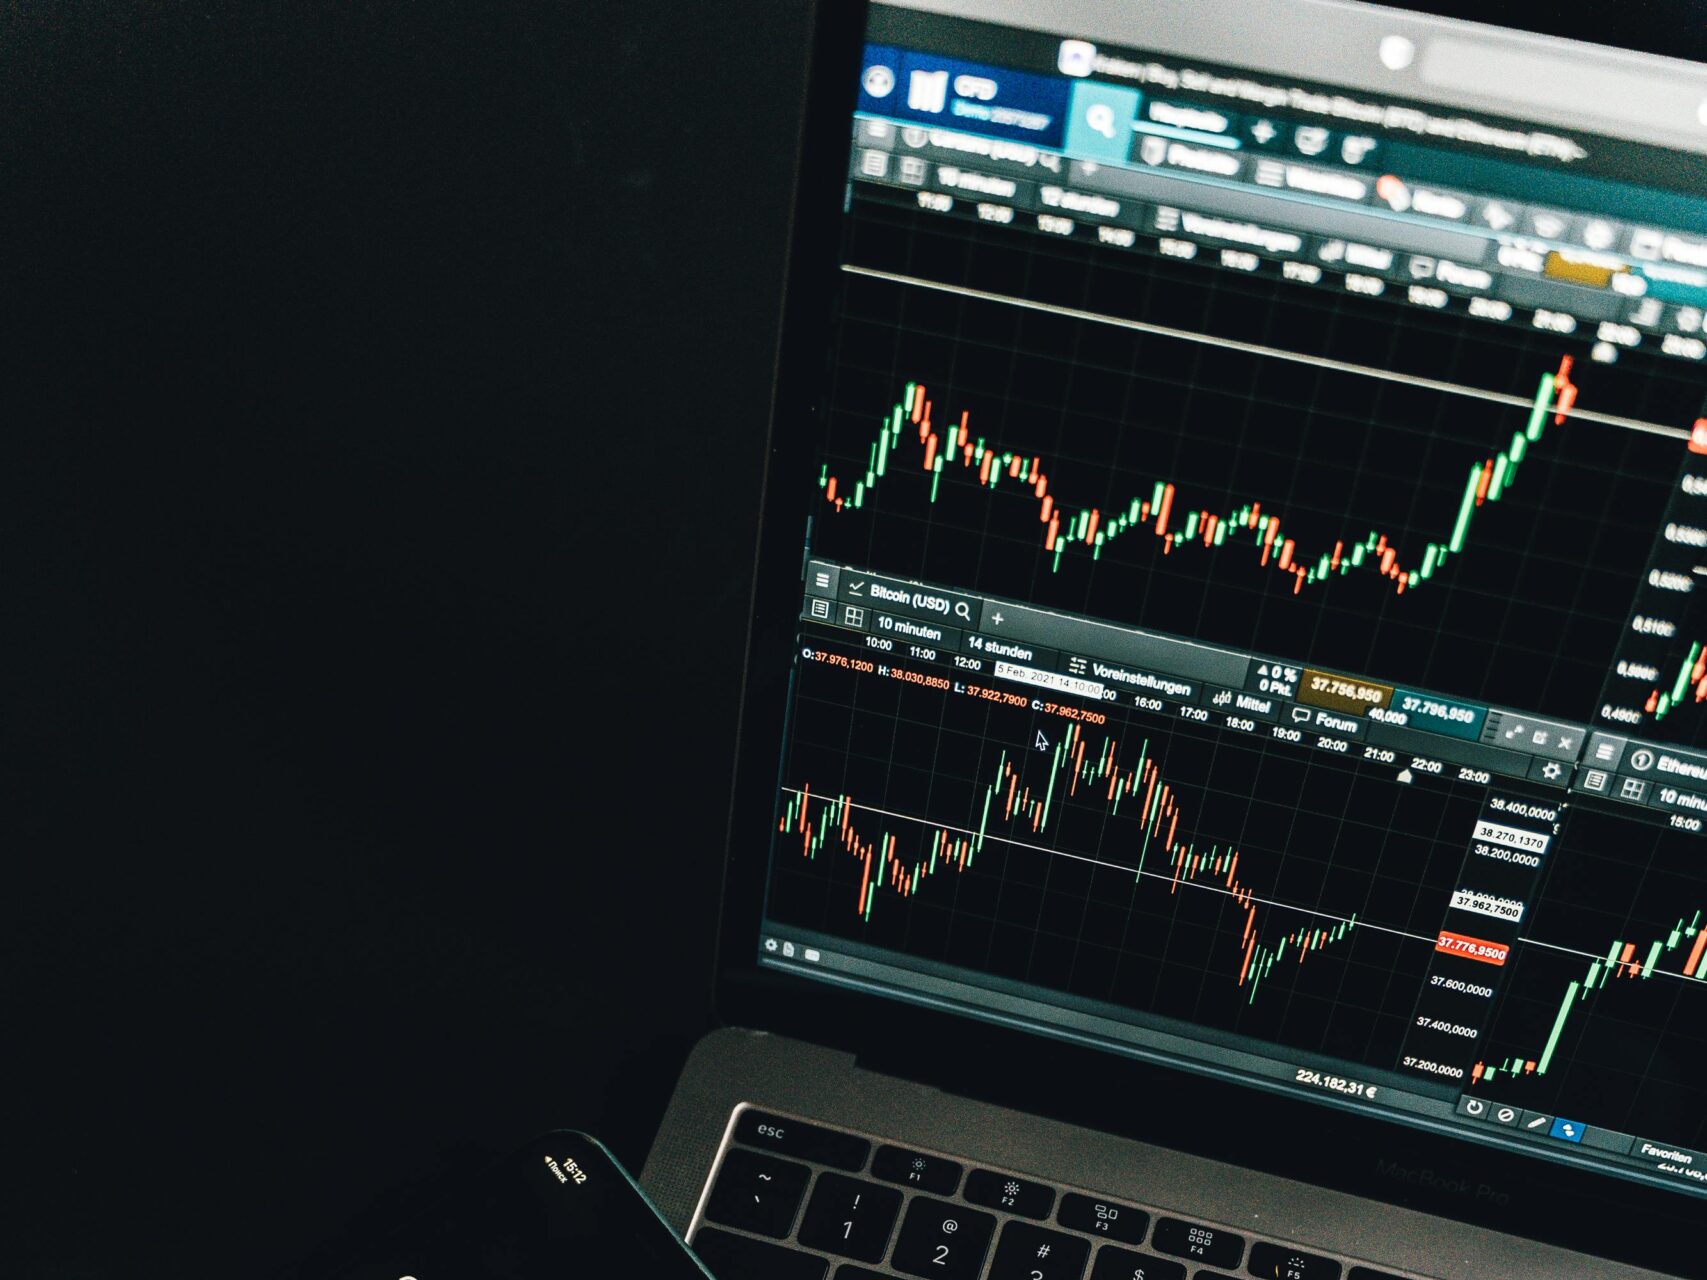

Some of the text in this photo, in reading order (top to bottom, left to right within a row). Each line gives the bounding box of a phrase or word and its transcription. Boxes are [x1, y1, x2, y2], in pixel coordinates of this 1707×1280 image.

[870, 583, 950, 615] Bitcoin (USD)
[878, 616, 942, 641] 10 minuten
[968, 636, 1033, 661] 14 stunden
[997, 664, 1005, 675] 5
[1272, 665, 1297, 683] 0 %
[1092, 663, 1192, 696] Voreinstellungen
[1259, 680, 1269, 692] 0
[865, 636, 893, 651] 10:00
[909, 646, 936, 661] 11:00
[954, 656, 981, 671] 12:00
[1134, 696, 1162, 711] 16:00
[1180, 706, 1208, 722] 17:00
[1226, 716, 1255, 732] 18:00
[1272, 727, 1301, 742] 19:00
[1317, 736, 1348, 752] 20:00
[1364, 747, 1395, 763] 21:00
[1411, 758, 1442, 774] 22:00
[1458, 768, 1490, 784] 23:00
[1236, 694, 1271, 713] Mittel
[1316, 712, 1358, 733] Forum
[1369, 708, 1408, 725] 40,000
[1601, 705, 1642, 724] 0,4900
[1660, 787, 1678, 804] 10
[1490, 798, 1556, 821] 38.400,0000
[1670, 814, 1702, 832] 15:00
[1480, 827, 1544, 849] 38.270,1370
[1475, 844, 1540, 868] 38.200,0000
[1457, 896, 1519, 918] 37.962,7500
[1438, 936, 1506, 961] 37.776,9500
[1430, 975, 1493, 999] 37.600,0000
[1416, 1016, 1478, 1039] 37.400,0000
[1403, 1056, 1464, 1079] 37.200,0000
[1296, 1069, 1378, 1099] 224.182,31 €
[757, 1122, 785, 1140] esc
[1641, 1143, 1693, 1165] Favoriten
[563, 1158, 587, 1184] 15:12
[909, 1172, 922, 1182] F1
[852, 1194, 861, 1210] !
[1002, 1196, 1015, 1207] F2
[843, 1221, 853, 1240] 1
[942, 1219, 958, 1234] @
[1095, 1221, 1109, 1232] F3
[932, 1245, 949, 1265] 2
[1037, 1244, 1051, 1259] #
[1190, 1245, 1204, 1256] F4
[1287, 1270, 1301, 1280] F5
